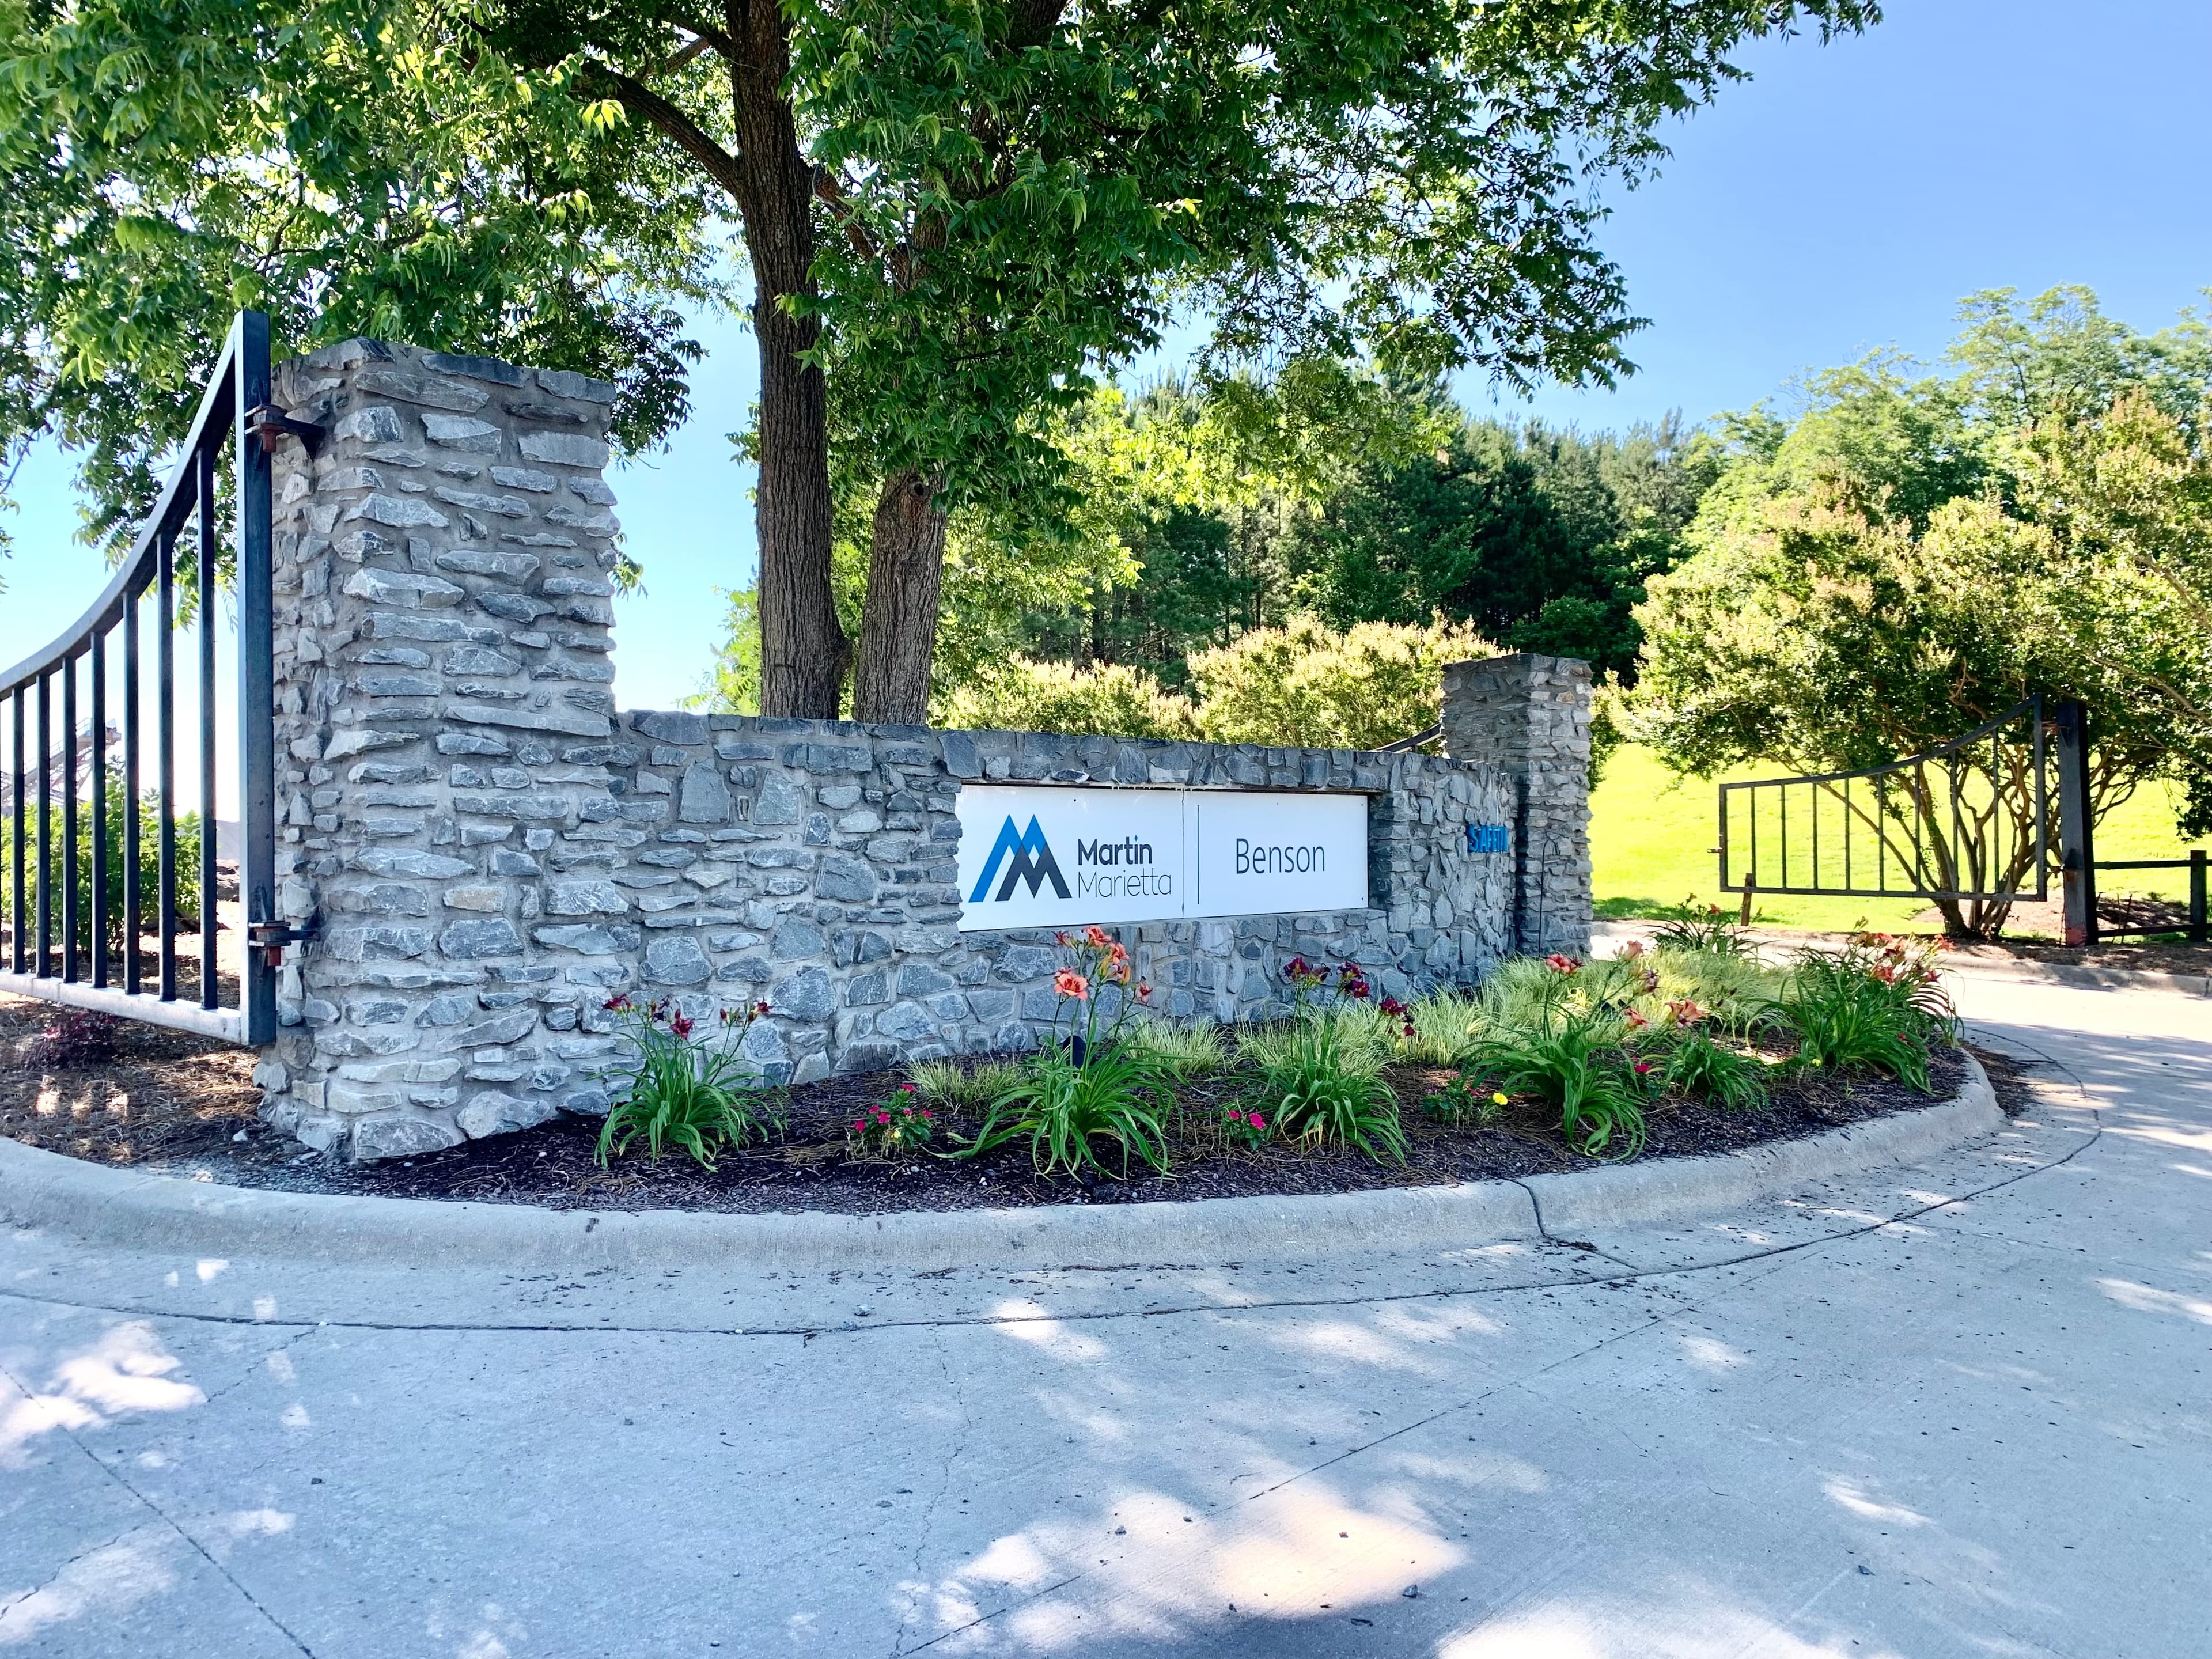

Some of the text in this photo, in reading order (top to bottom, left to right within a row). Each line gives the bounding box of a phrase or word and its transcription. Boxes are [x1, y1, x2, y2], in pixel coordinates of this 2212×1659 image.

[1078, 835, 1153, 865] Martin
[1236, 838, 1325, 874] Benson
[1078, 868, 1171, 898] Marietta
